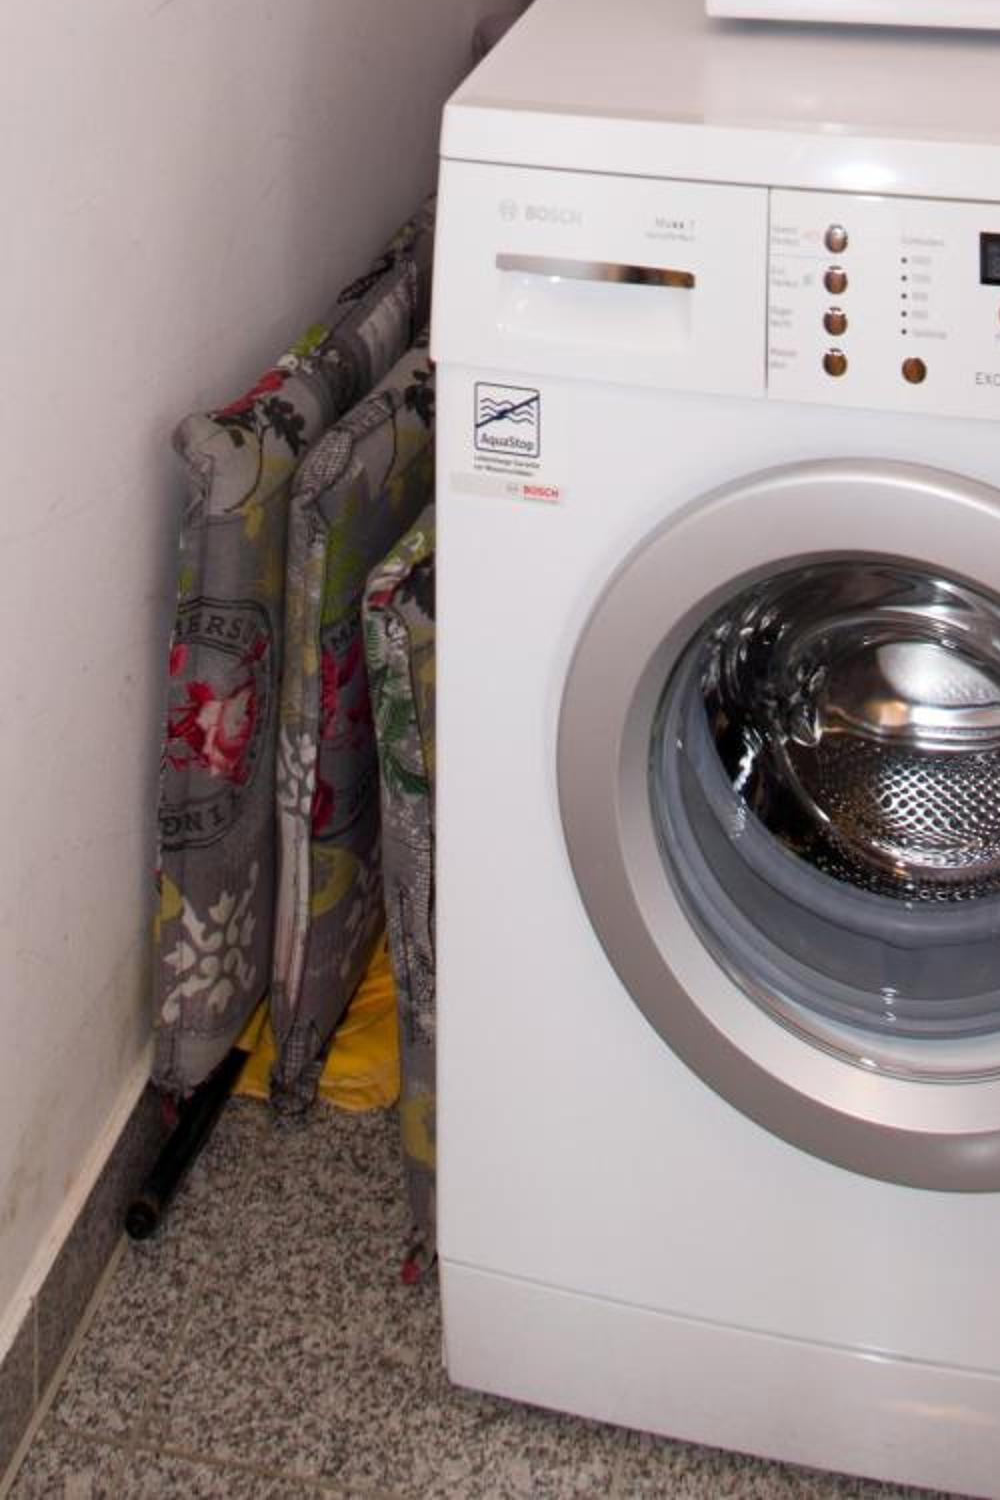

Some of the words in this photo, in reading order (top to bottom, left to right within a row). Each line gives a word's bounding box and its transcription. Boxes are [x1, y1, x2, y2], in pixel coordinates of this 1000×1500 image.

[524, 204, 584, 227] BOSCH
[480, 432, 535, 452] AquaStop
[523, 484, 560, 499] BOSCH
